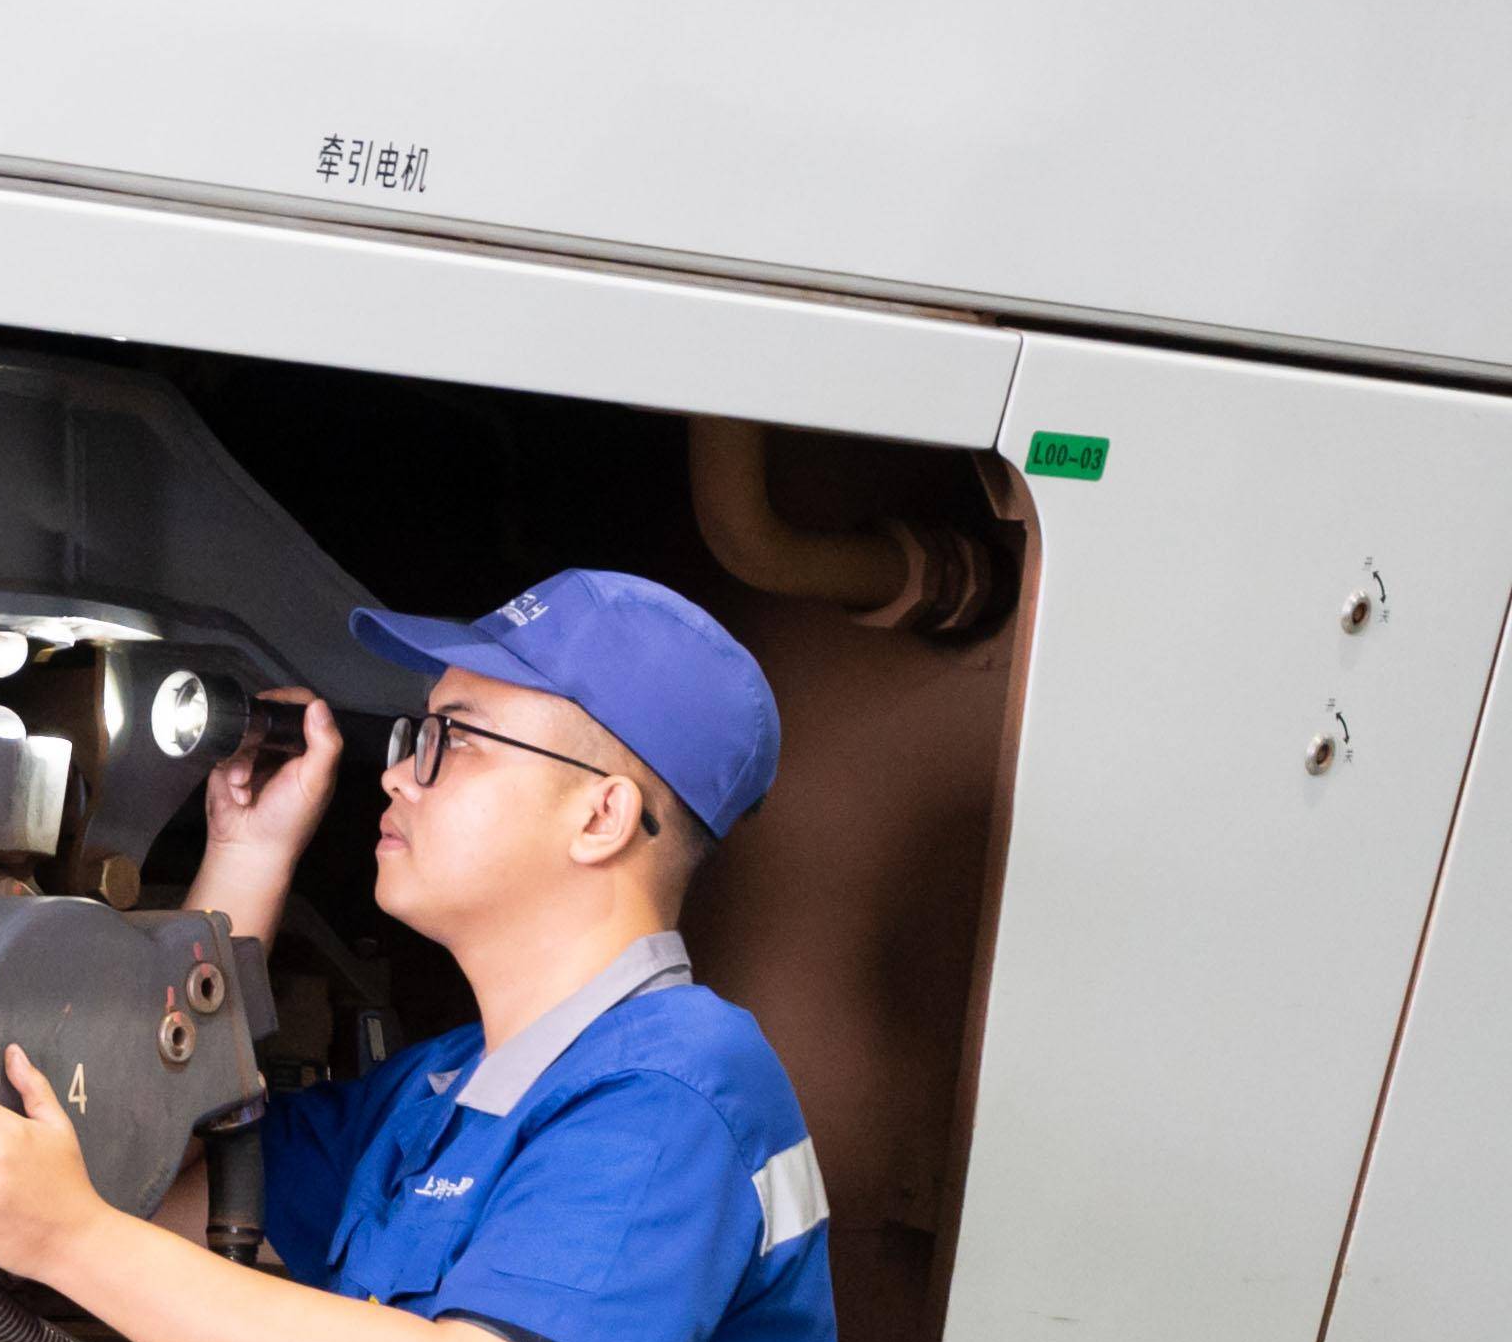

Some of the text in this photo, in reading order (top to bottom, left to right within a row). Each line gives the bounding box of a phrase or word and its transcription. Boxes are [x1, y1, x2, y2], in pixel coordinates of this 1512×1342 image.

[316, 133, 428, 193] 牵引电机
[1033, 441, 1104, 470] L00-03
[67, 1062, 88, 1114] 4
